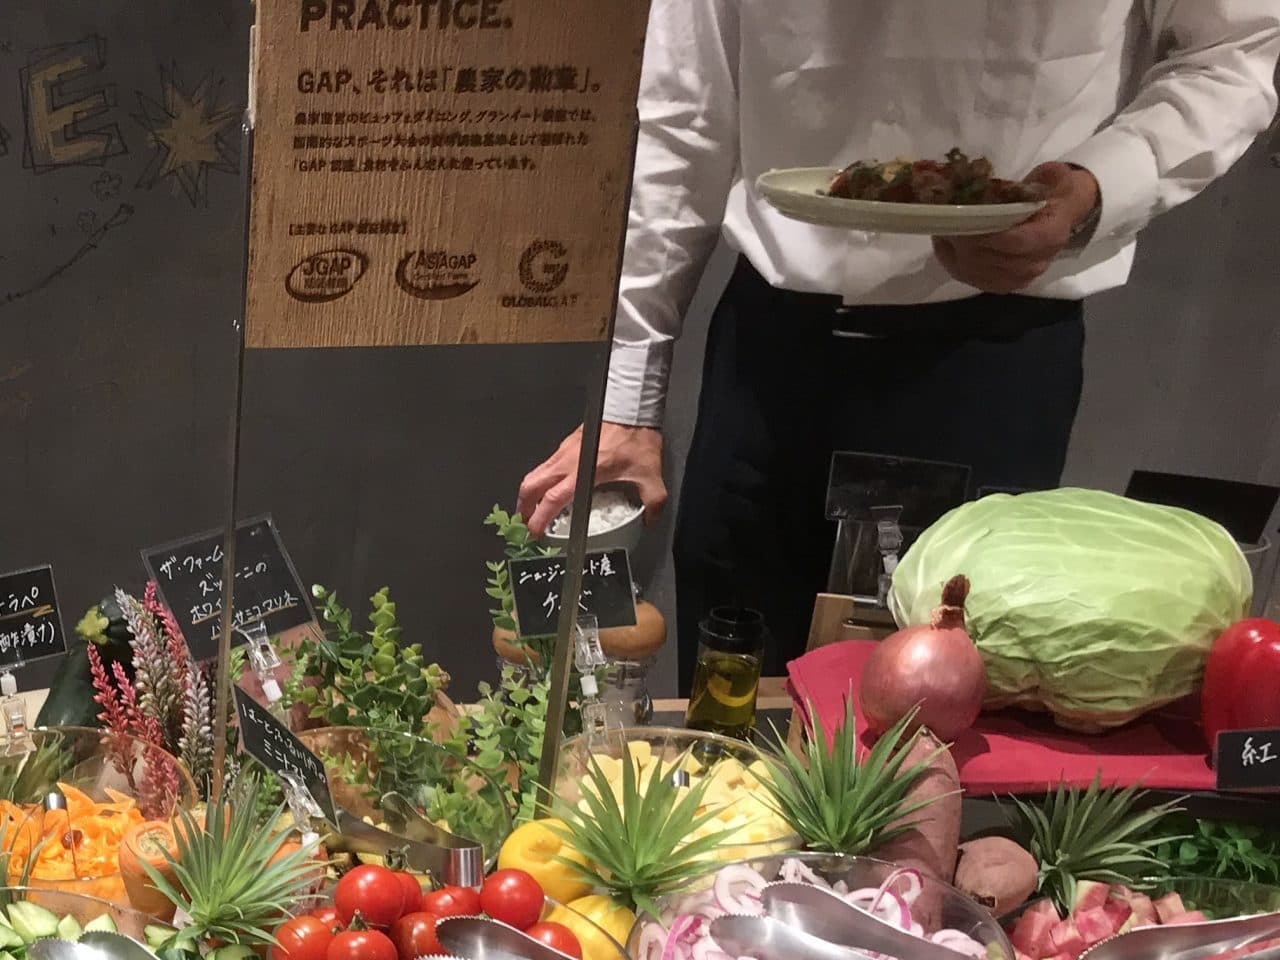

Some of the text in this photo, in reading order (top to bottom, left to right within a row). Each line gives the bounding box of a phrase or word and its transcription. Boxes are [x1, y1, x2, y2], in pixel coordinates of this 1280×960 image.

[300, 0, 513, 32] PRACTICE.
[301, 256, 352, 277] JGAP
[414, 250, 477, 270] ASIAGAP
[519, 553, 616, 585] ニュージード産
[1241, 736, 1278, 767] 紅
